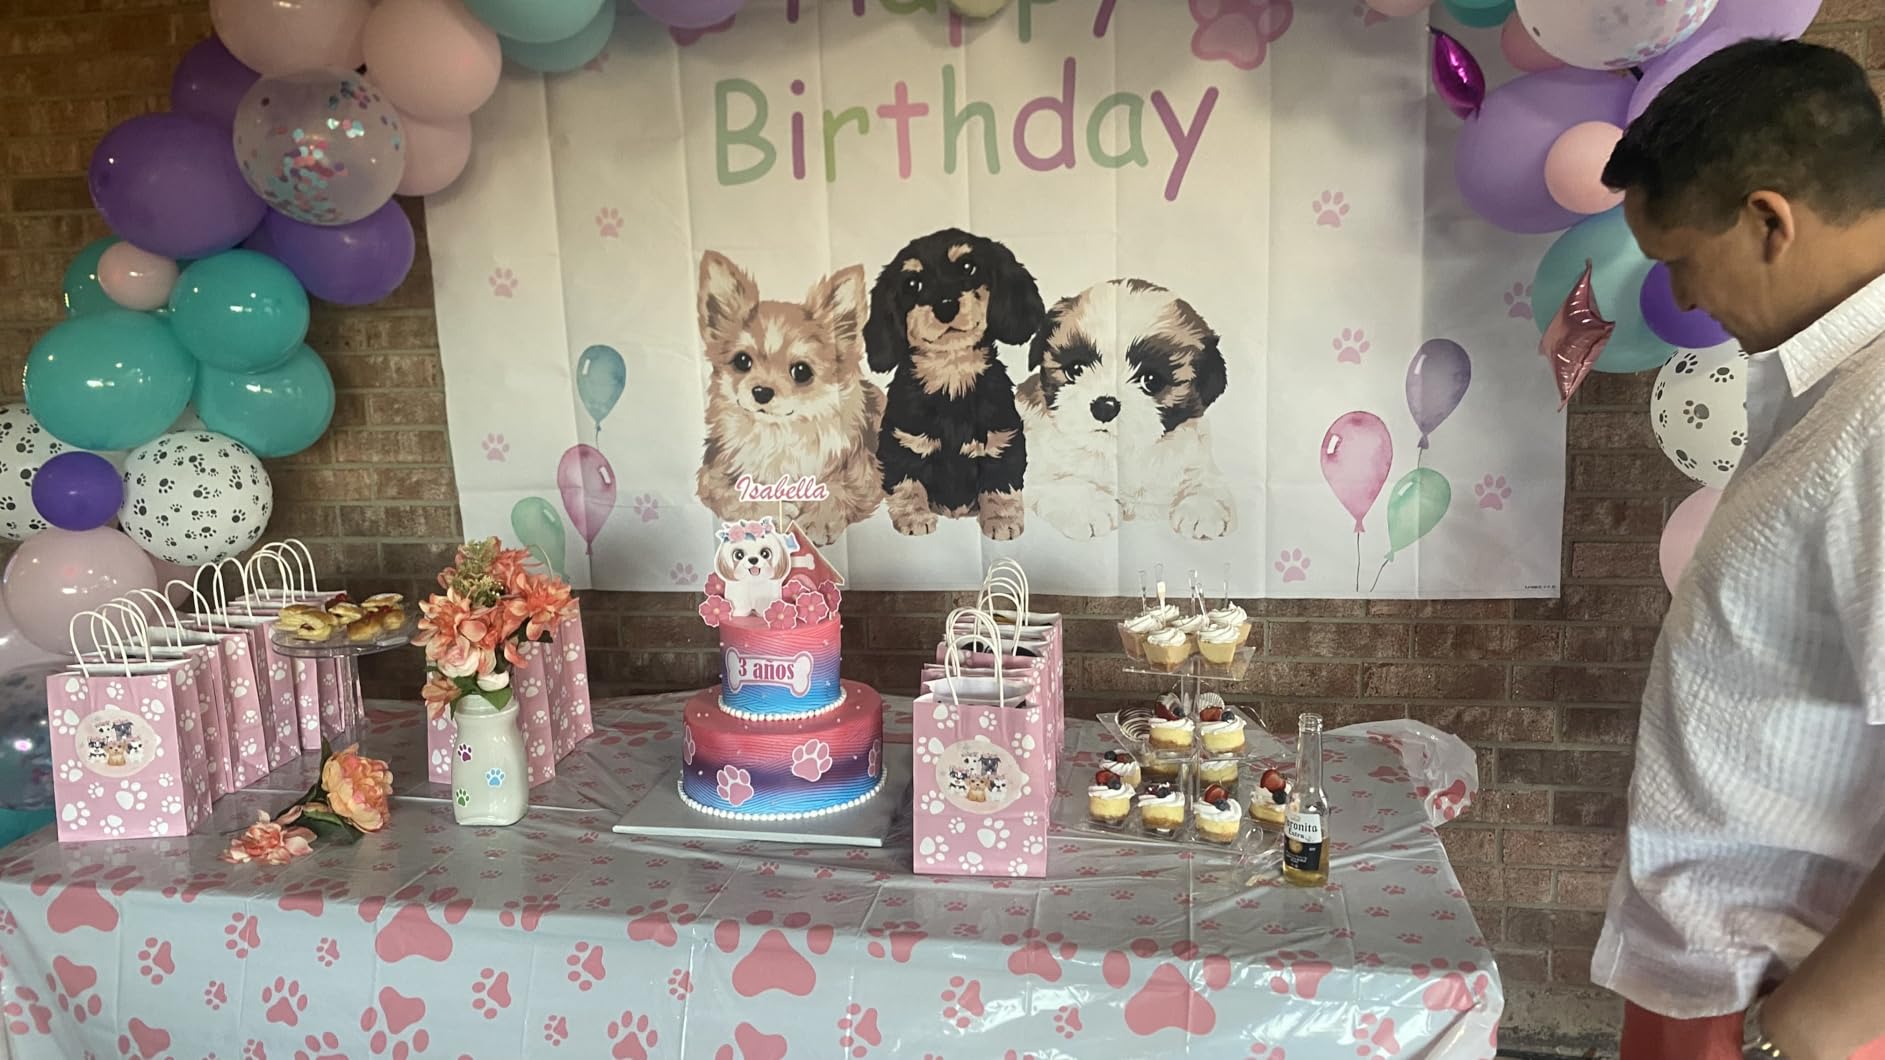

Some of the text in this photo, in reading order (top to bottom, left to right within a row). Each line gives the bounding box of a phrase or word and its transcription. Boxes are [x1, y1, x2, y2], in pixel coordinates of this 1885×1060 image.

[713, 56, 1219, 202] Birthday
[735, 475, 828, 501] Isabella
[738, 657, 795, 681] 3 años
